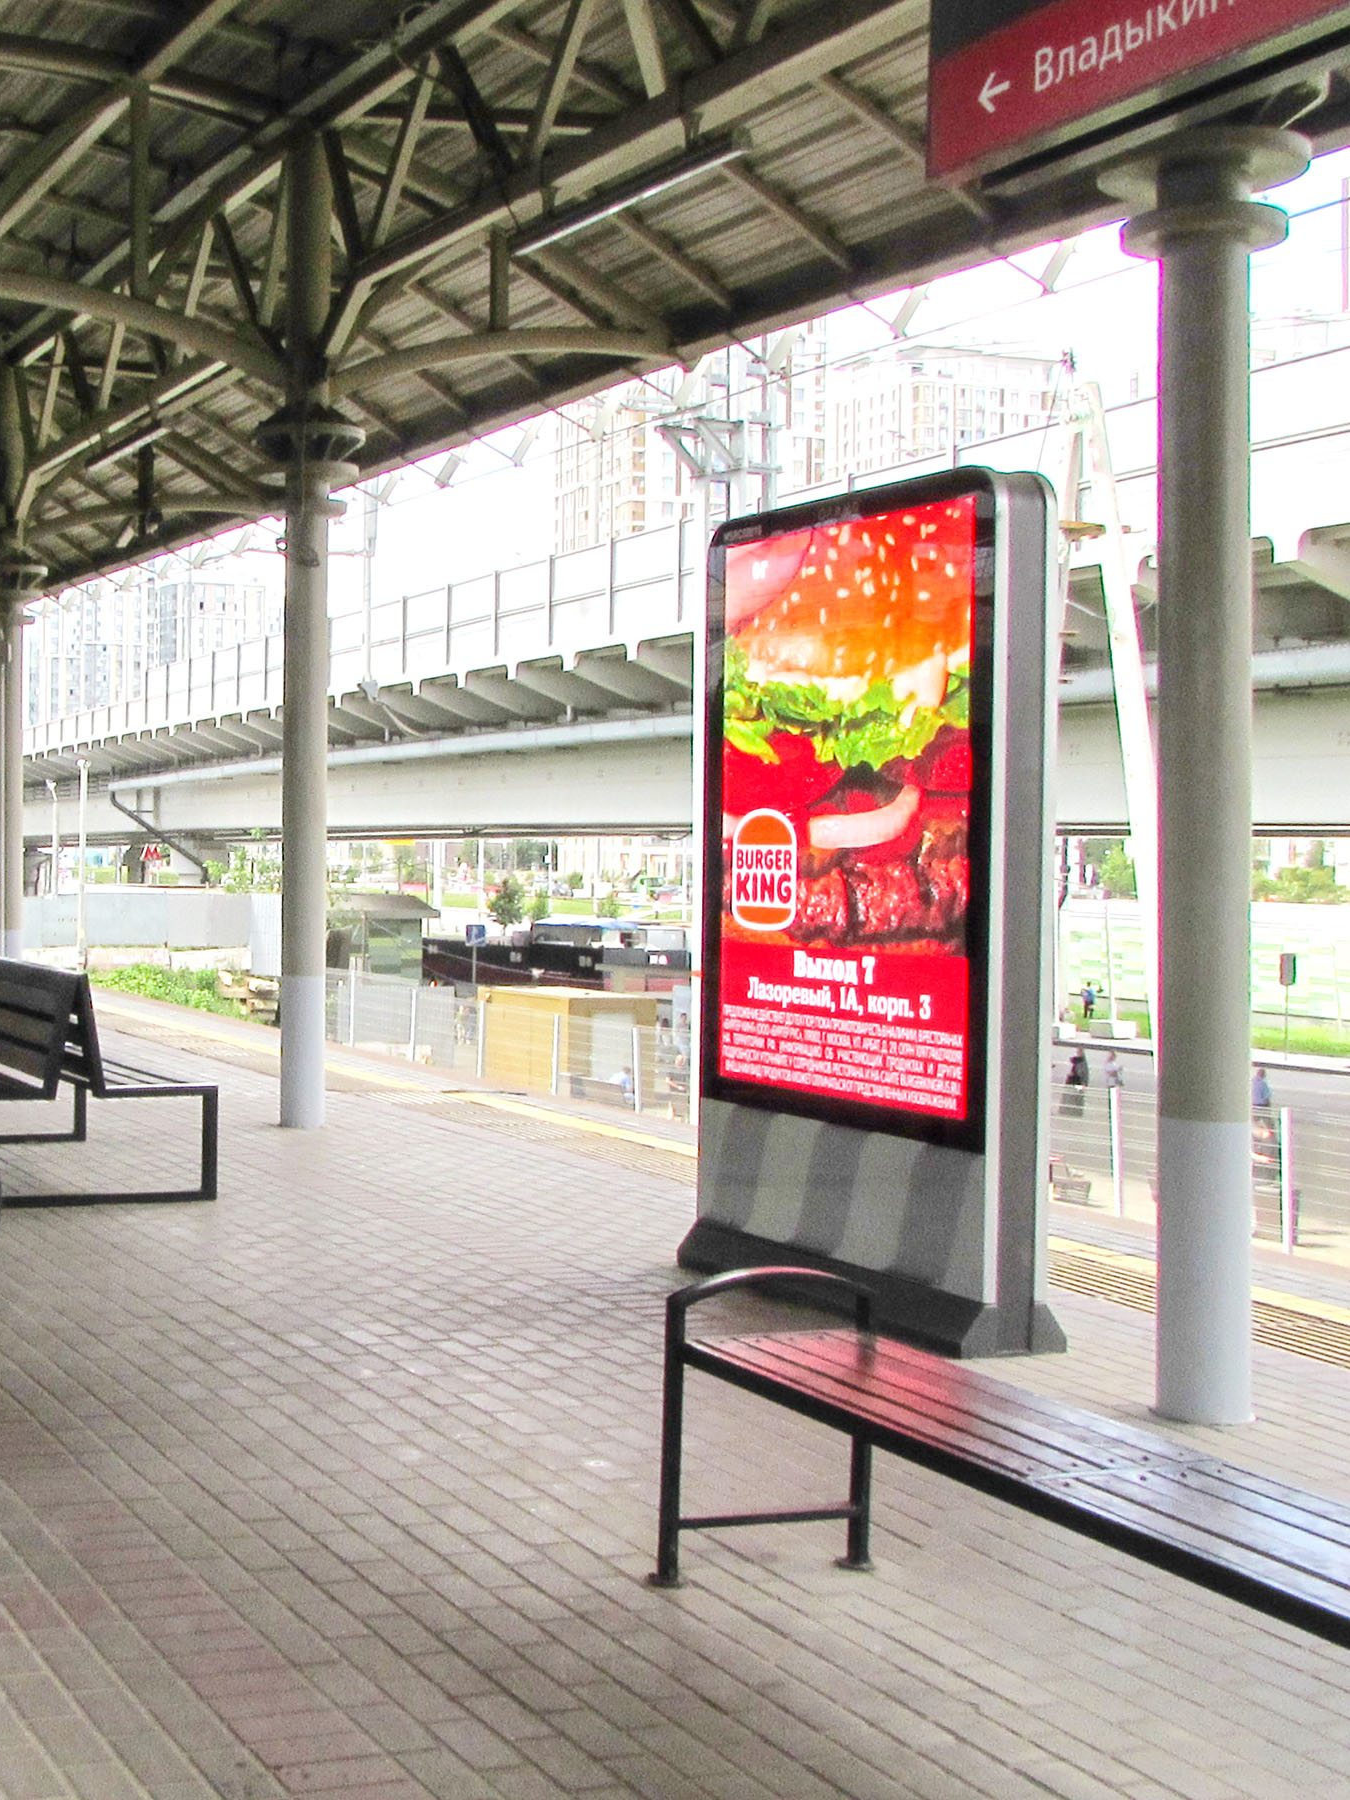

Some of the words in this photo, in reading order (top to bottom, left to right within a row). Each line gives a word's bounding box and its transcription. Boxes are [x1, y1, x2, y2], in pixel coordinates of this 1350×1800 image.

[736, 848, 792, 871] BURGER
[736, 873, 792, 905] KING
[793, 950, 859, 985] Выход
[862, 955, 876, 985] 7
[747, 976, 837, 1013] Лазоревый,
[867, 992, 915, 1022] корп.
[919, 994, 931, 1020] 3
